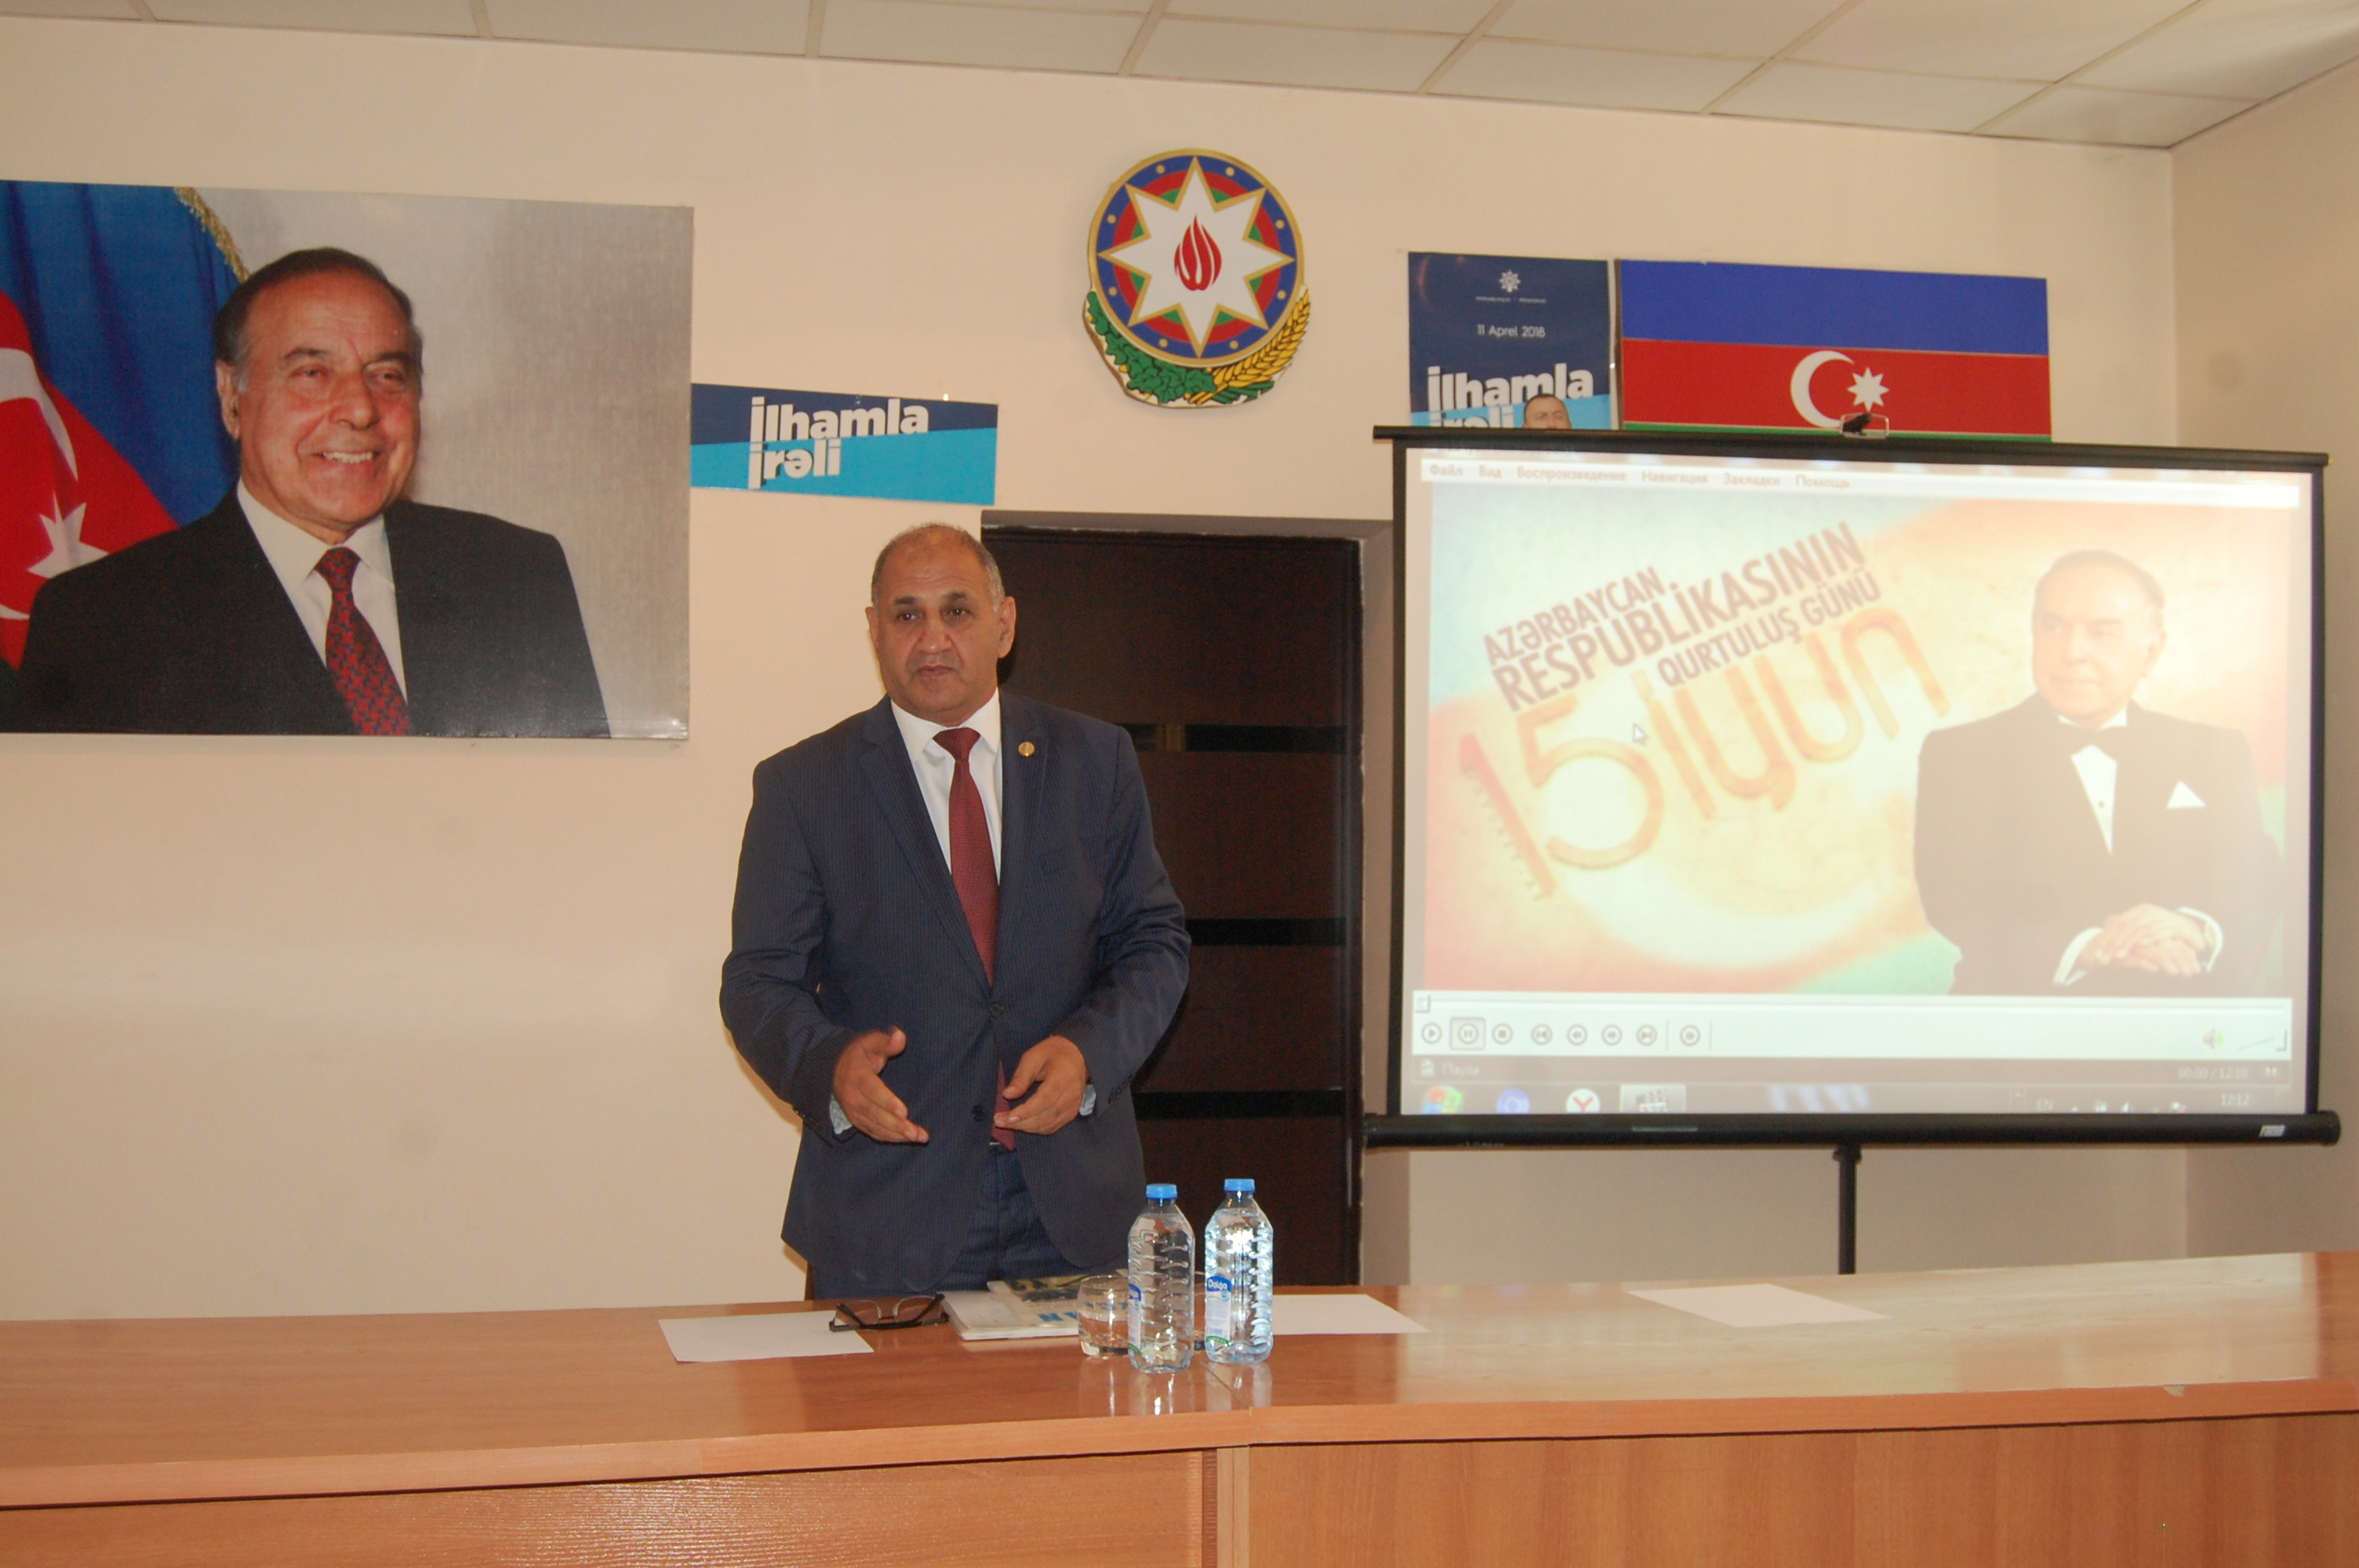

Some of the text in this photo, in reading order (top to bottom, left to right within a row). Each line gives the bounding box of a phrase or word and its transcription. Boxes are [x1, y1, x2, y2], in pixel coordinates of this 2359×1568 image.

[1477, 324, 1546, 339] 11 Aprel 2018
[1430, 464, 1850, 488] Файл Вид Воспроизведение Навигация Закладки Помощь
[1484, 566, 1666, 667] AZƏRBAYCAN
[1492, 521, 1865, 712] RESPUBLİKASININ
[1657, 567, 1882, 688] QURTULUŞ GÜNÜ
[1458, 692, 1665, 897] 15
